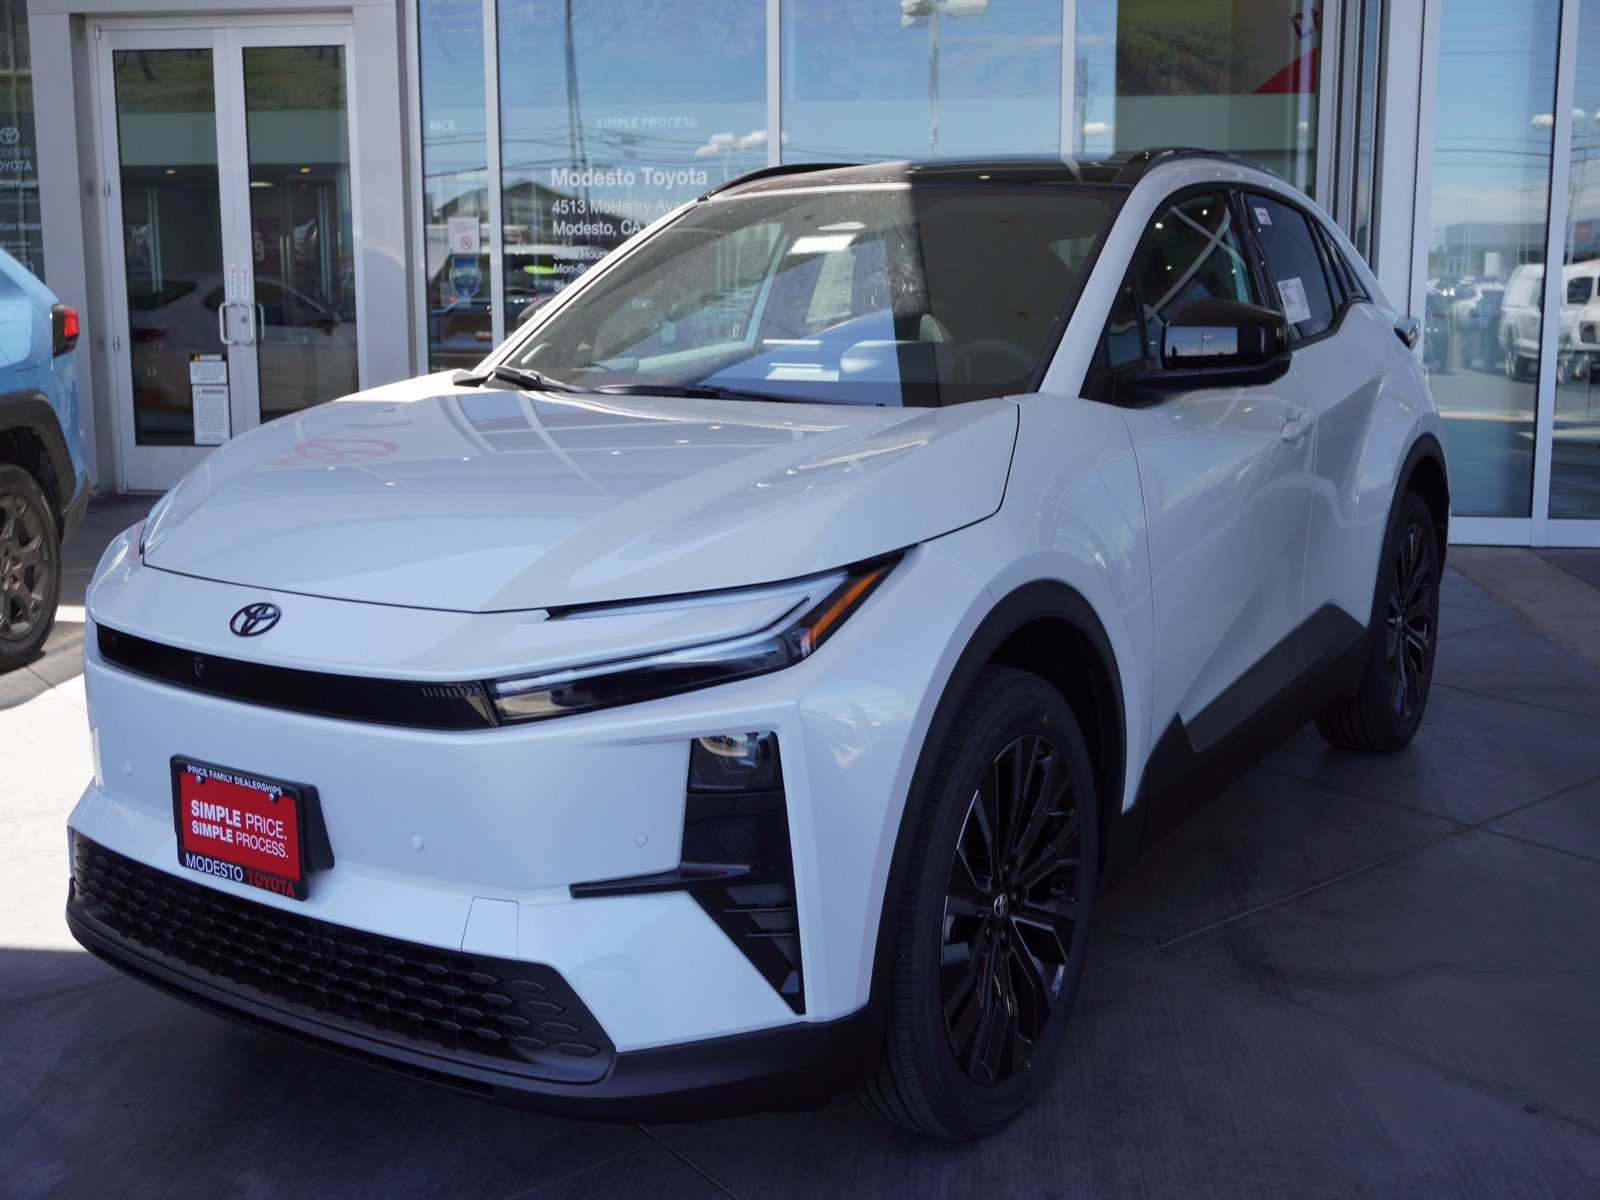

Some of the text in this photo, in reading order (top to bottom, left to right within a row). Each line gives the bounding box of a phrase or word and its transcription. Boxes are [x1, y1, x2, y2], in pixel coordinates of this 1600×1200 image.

[595, 116, 700, 129] SIMPLE PROCESS.
[551, 167, 708, 190] Modesto Toyota
[551, 199, 586, 215] 4513
[590, 199, 651, 218] McHenry
[552, 220, 617, 237] Modesto,
[620, 220, 642, 235] CA
[553, 249, 579, 260] Sales
[553, 263, 592, 274] Mon-Su
[201, 388, 225, 396] WARNING
[187, 765, 283, 796] PRICE FAMILY DEALERSHIPS
[191, 799, 288, 840] SIMPLE PRICE.
[191, 820, 289, 859] SIMPLE PROCESS.
[186, 852, 296, 898] MODESTO TOYOTA
